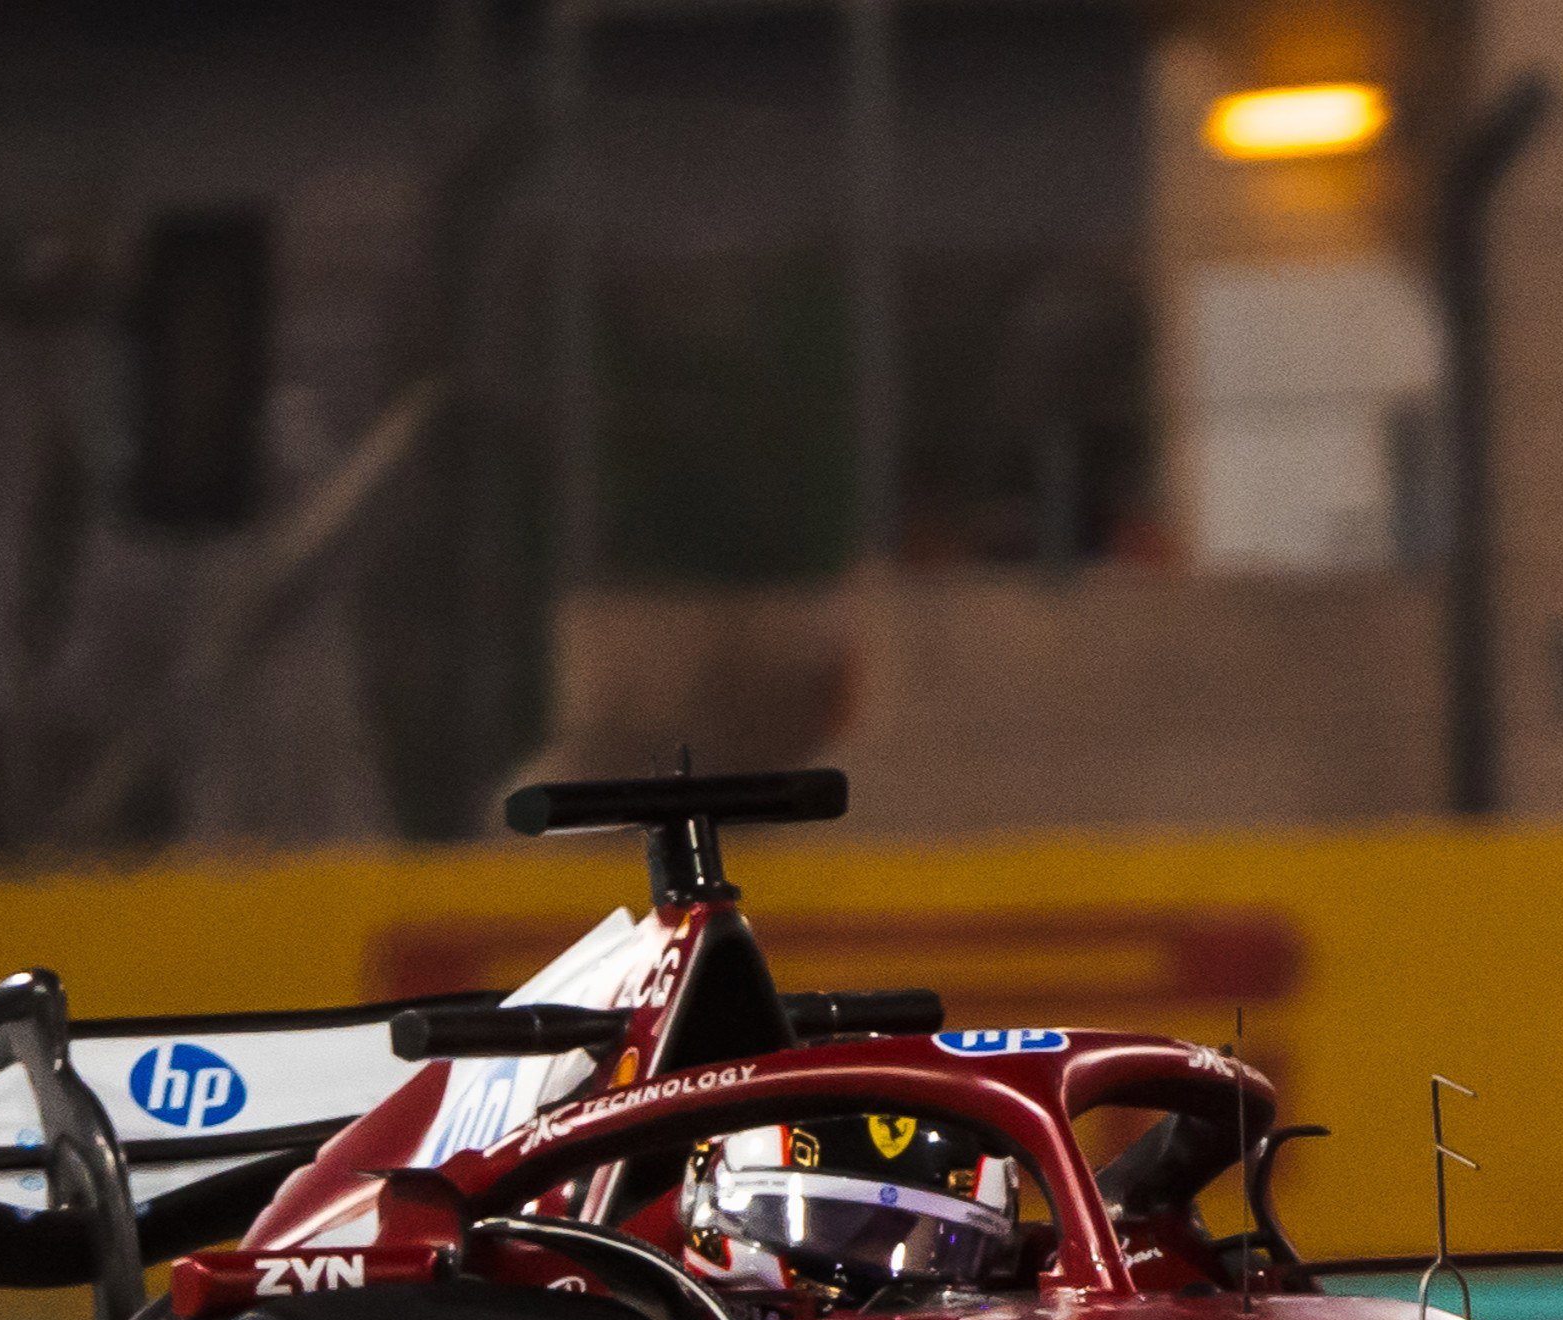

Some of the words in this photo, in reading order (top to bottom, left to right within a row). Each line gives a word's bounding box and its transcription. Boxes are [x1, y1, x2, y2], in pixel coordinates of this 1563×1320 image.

[147, 1043, 233, 1128] hp
[583, 1062, 758, 1115] TECHNOLOGY
[255, 1255, 364, 1296] ZYN
